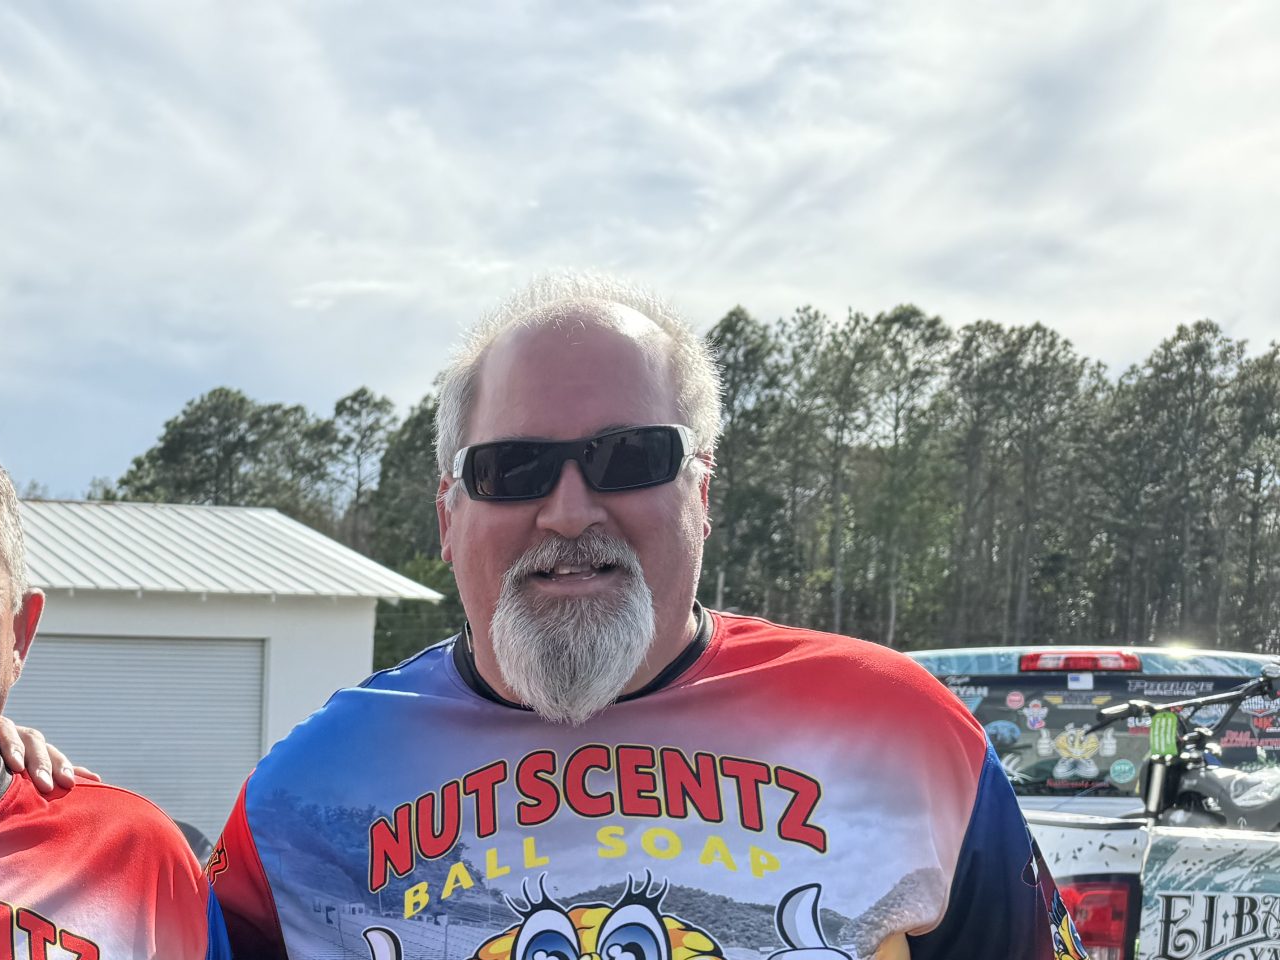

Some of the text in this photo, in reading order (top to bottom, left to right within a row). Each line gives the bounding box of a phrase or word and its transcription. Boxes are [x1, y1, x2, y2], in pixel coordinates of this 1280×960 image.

[367, 743, 828, 895] NUTSCENTZ
[404, 826, 781, 920] BALL SOAP
